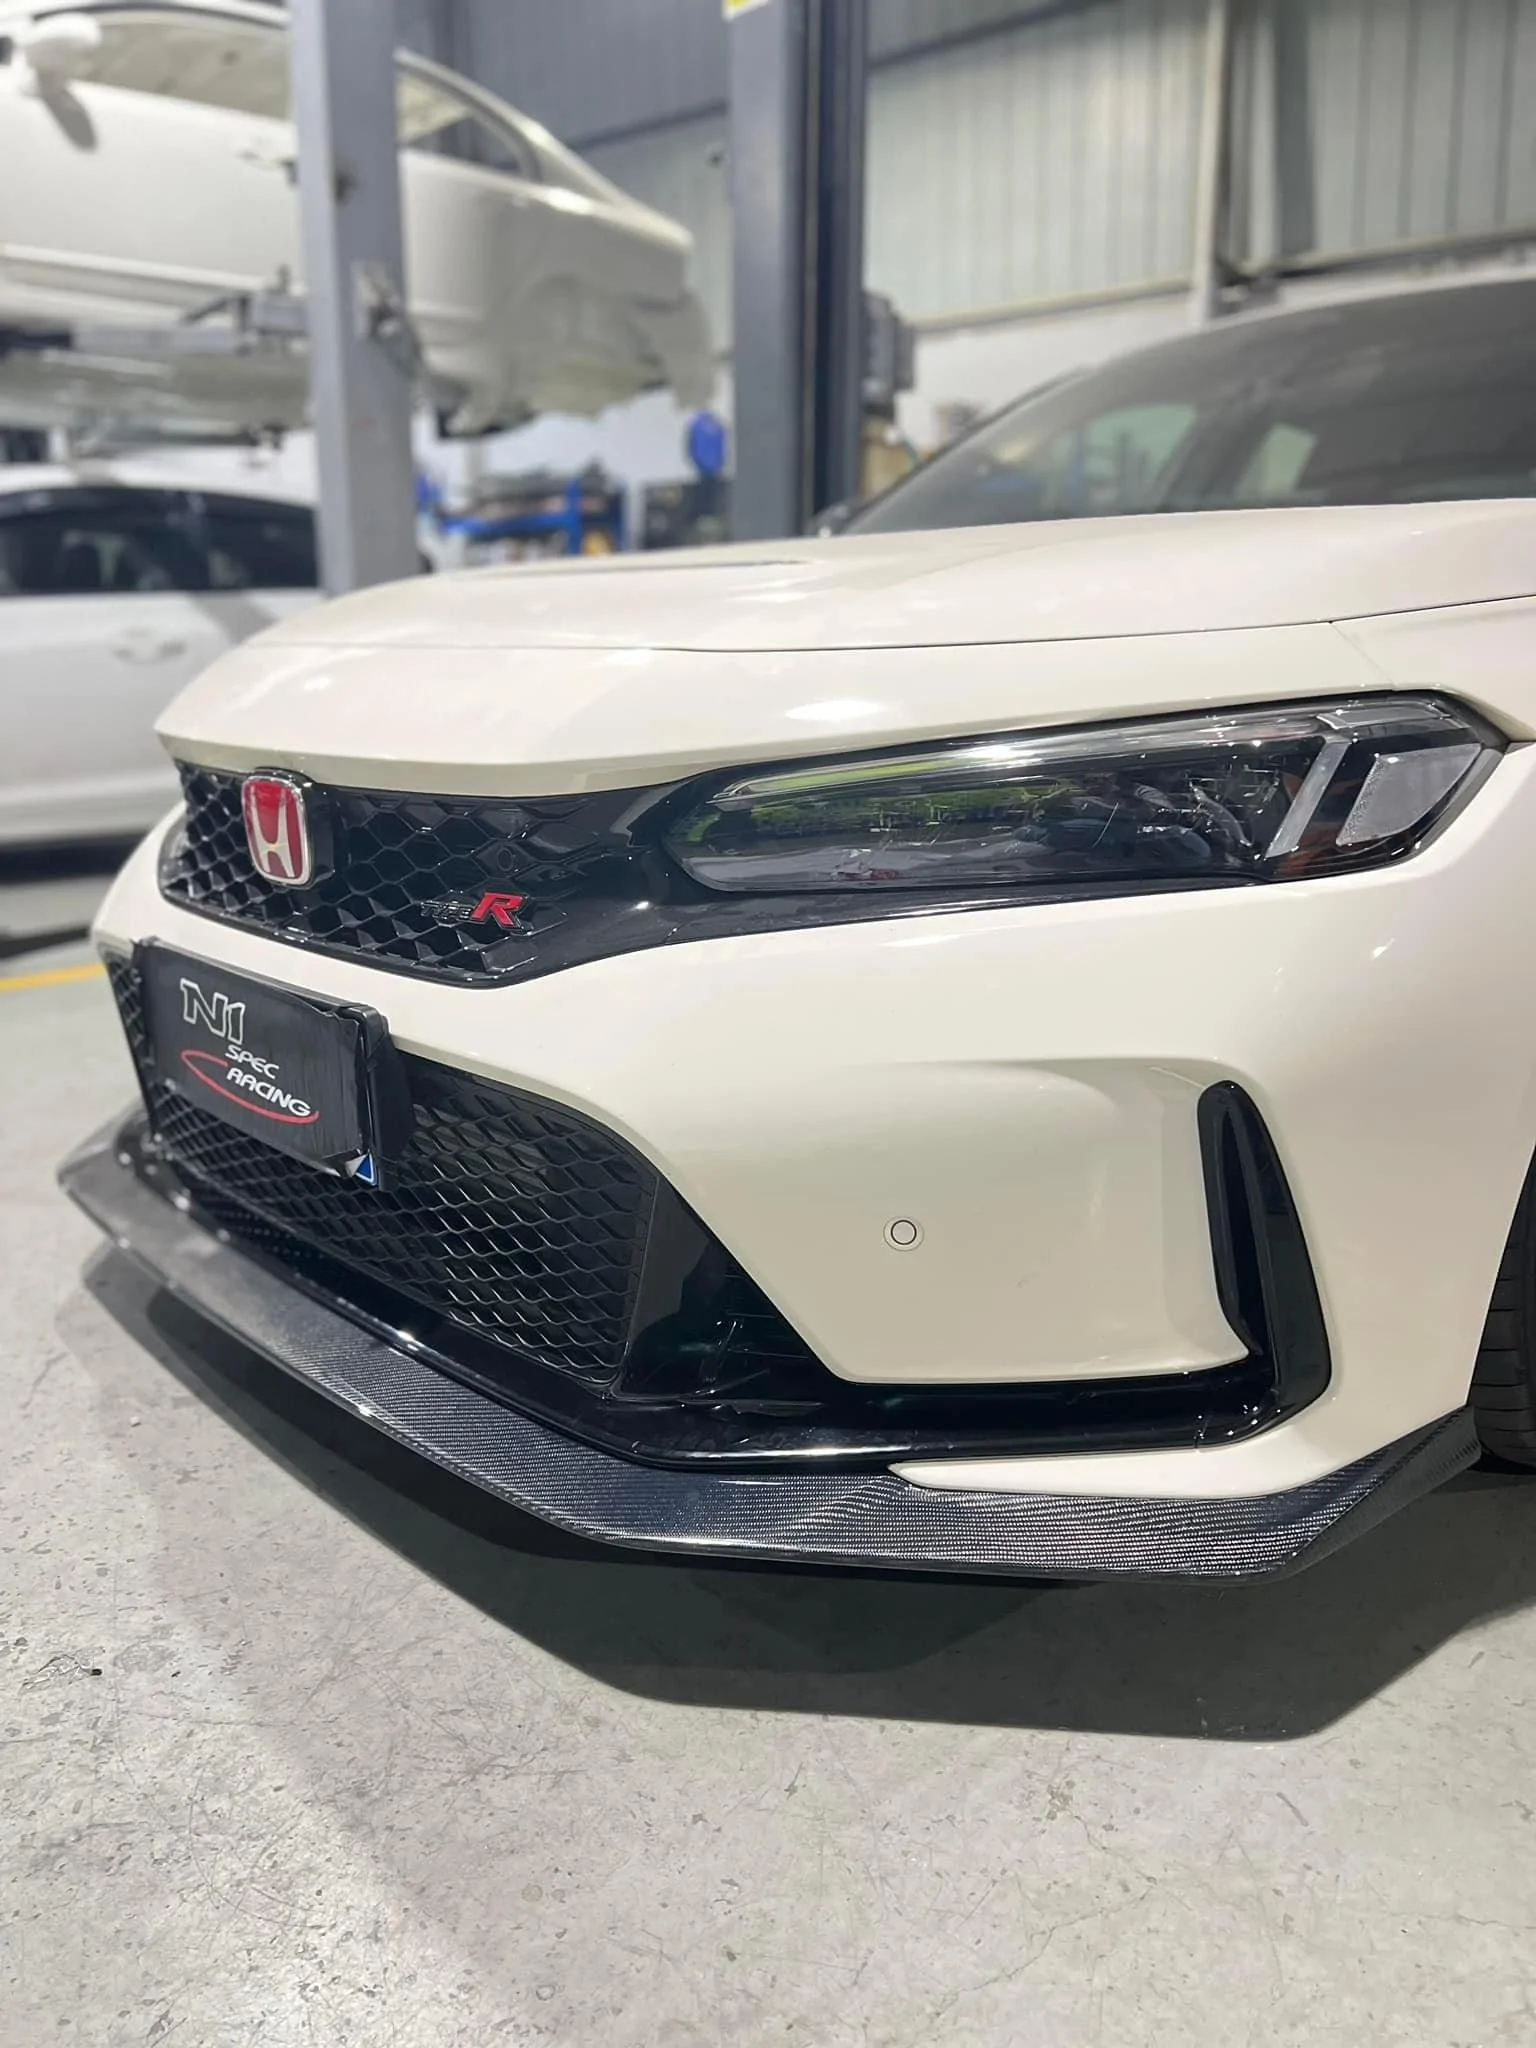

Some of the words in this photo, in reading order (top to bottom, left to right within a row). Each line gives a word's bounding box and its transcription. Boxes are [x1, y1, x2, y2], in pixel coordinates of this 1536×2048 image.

[471, 892, 524, 927] R
[180, 978, 245, 1045] N1
[225, 1044, 280, 1080] SPEC
[226, 1067, 311, 1117] RACING
